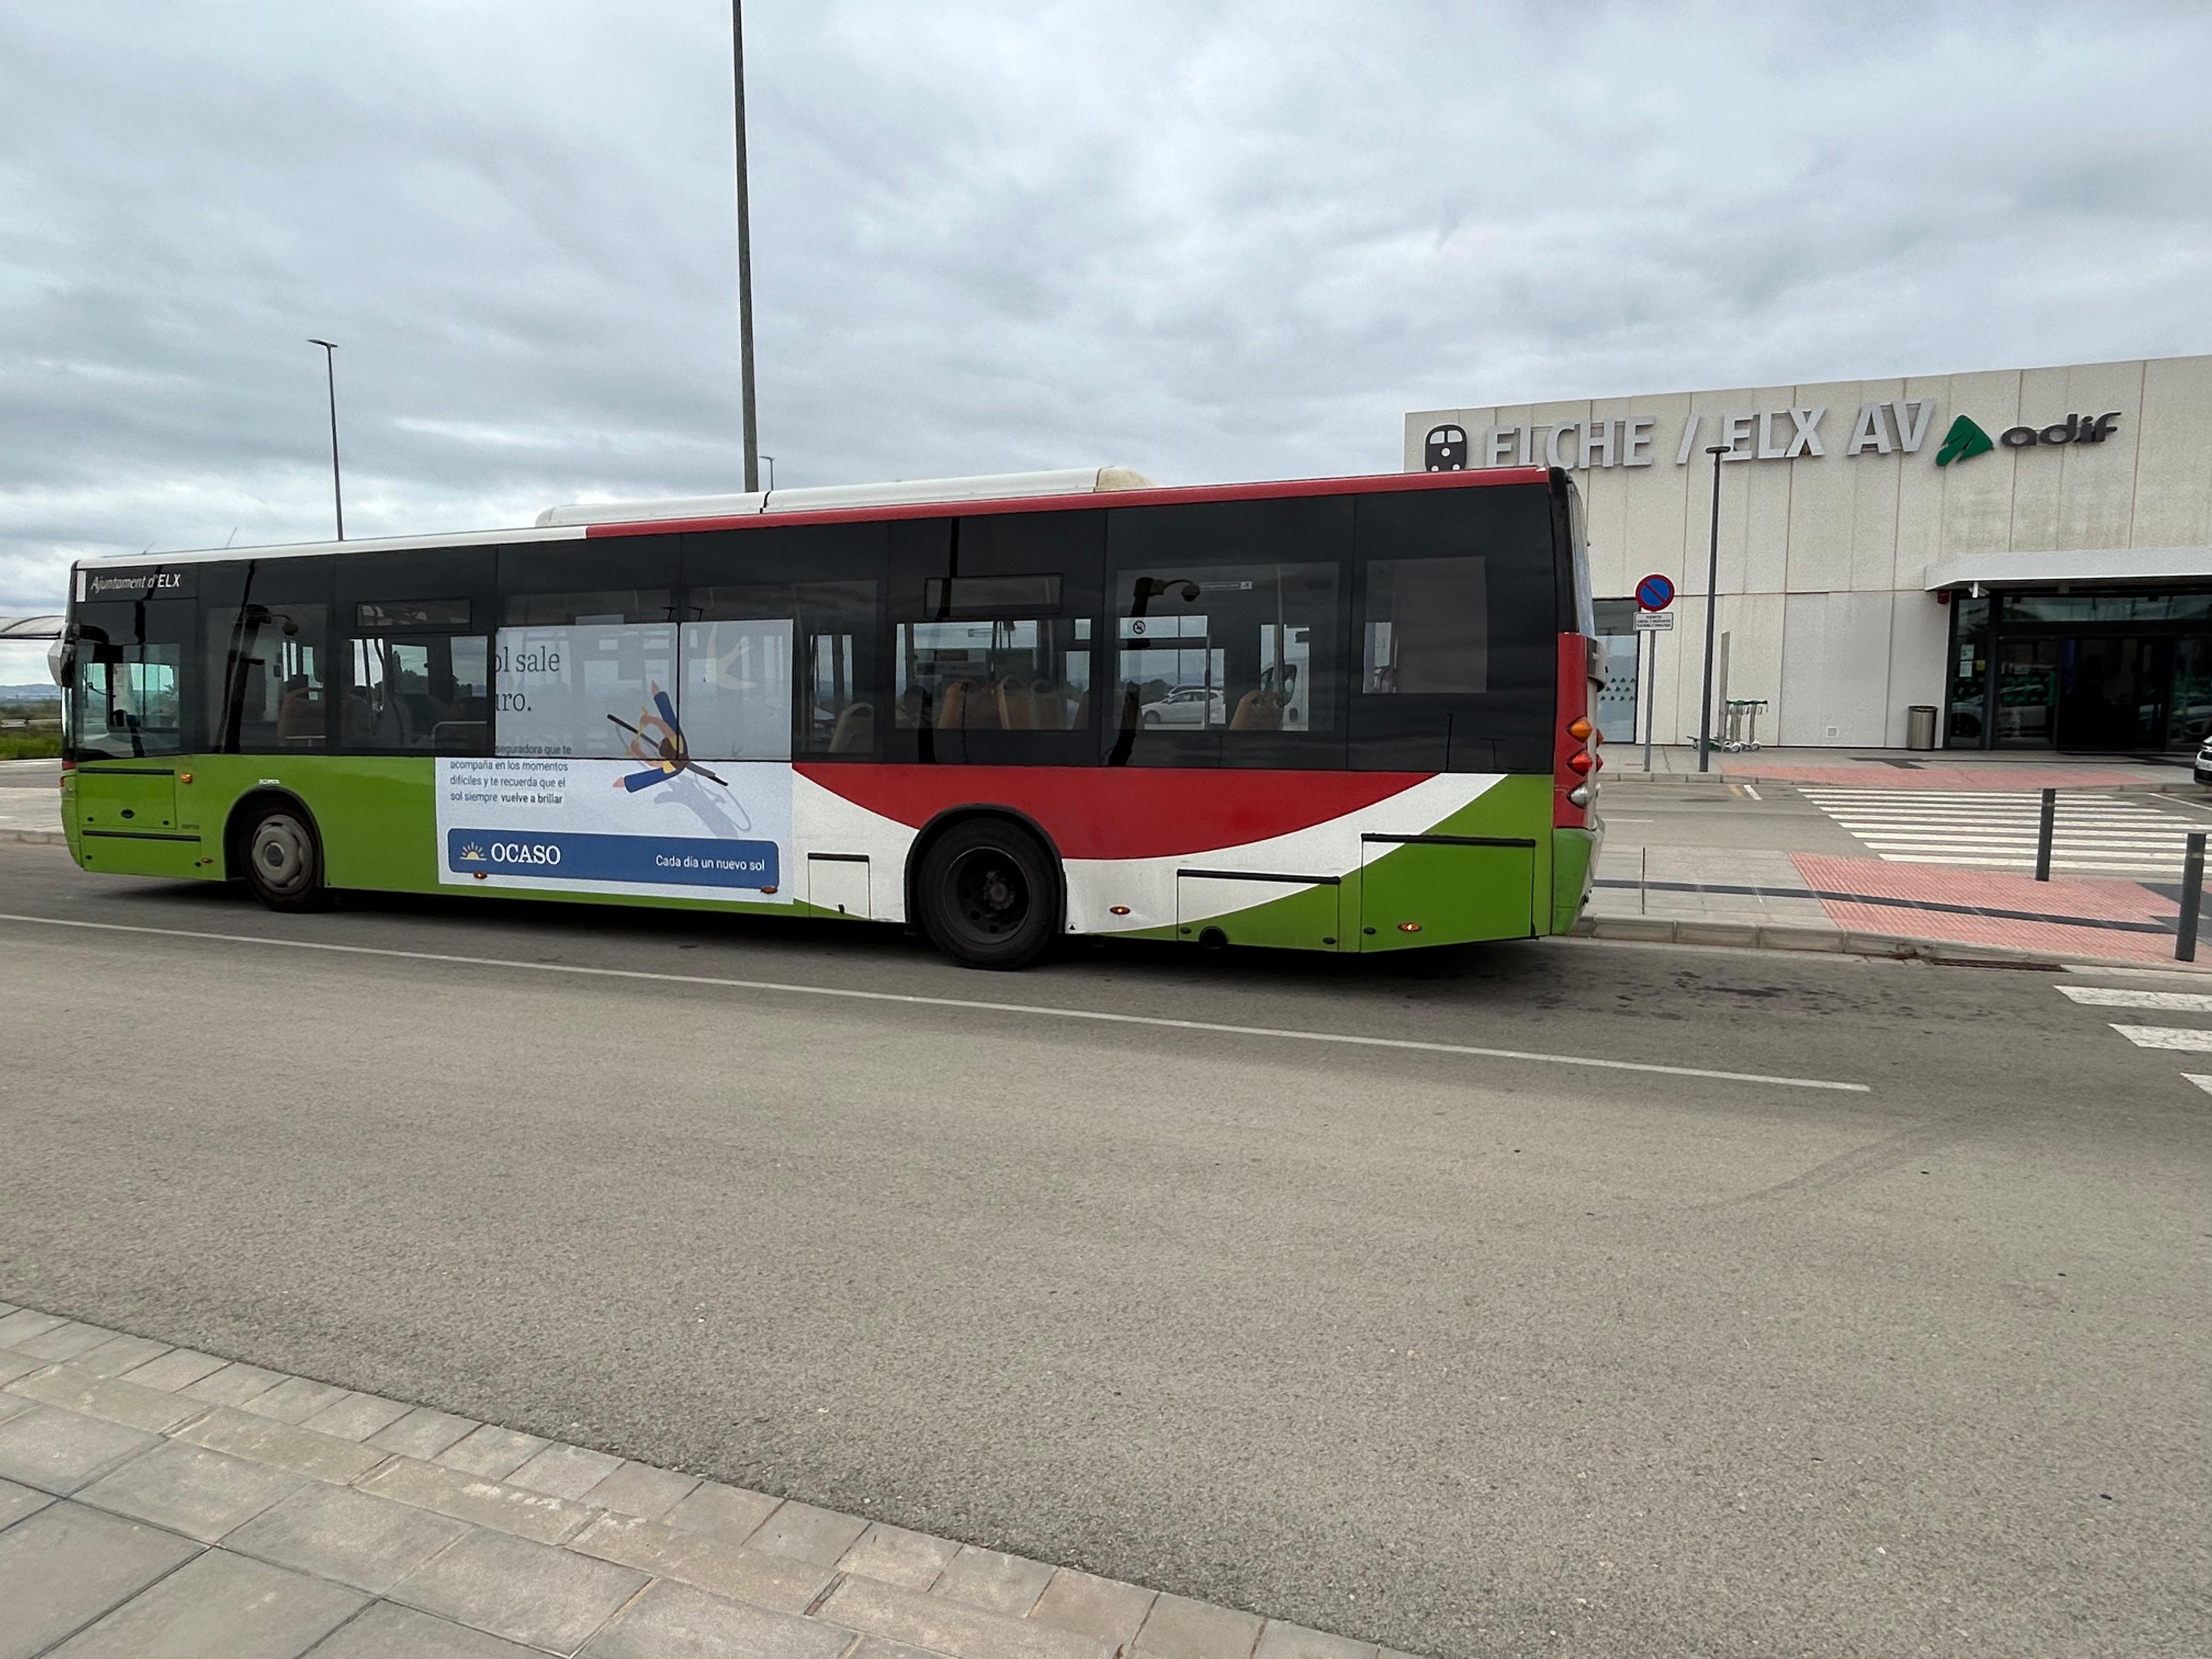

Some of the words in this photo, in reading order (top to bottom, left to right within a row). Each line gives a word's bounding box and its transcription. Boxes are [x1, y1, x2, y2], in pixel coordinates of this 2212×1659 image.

[1486, 416, 1656, 470] ELCHE
[1676, 413, 1701, 465] /
[1722, 407, 1828, 462] ELX
[1847, 397, 1935, 456] AV
[2000, 411, 2122, 446] adif
[91, 575, 145, 594] Ajuntament
[148, 573, 181, 588] d'ELX
[516, 645, 560, 672] sale
[544, 745, 562, 755] que
[563, 745, 572, 754] te
[450, 760, 493, 771] acompaña
[507, 760, 520, 770] los
[522, 761, 568, 771] momentos
[483, 778, 488, 787] y
[490, 776, 499, 786] te
[500, 777, 538, 787] recuerda
[539, 778, 556, 789] que
[557, 777, 566, 788] el
[450, 791, 463, 802] sol
[465, 792, 498, 803] siempre
[500, 793, 528, 803] vuelve
[538, 793, 563, 804] brillar
[491, 843, 561, 865] OCASO
[656, 855, 681, 867] Cada
[701, 859, 714, 868] un
[716, 860, 747, 871] nuevo
[749, 859, 765, 871] sol
